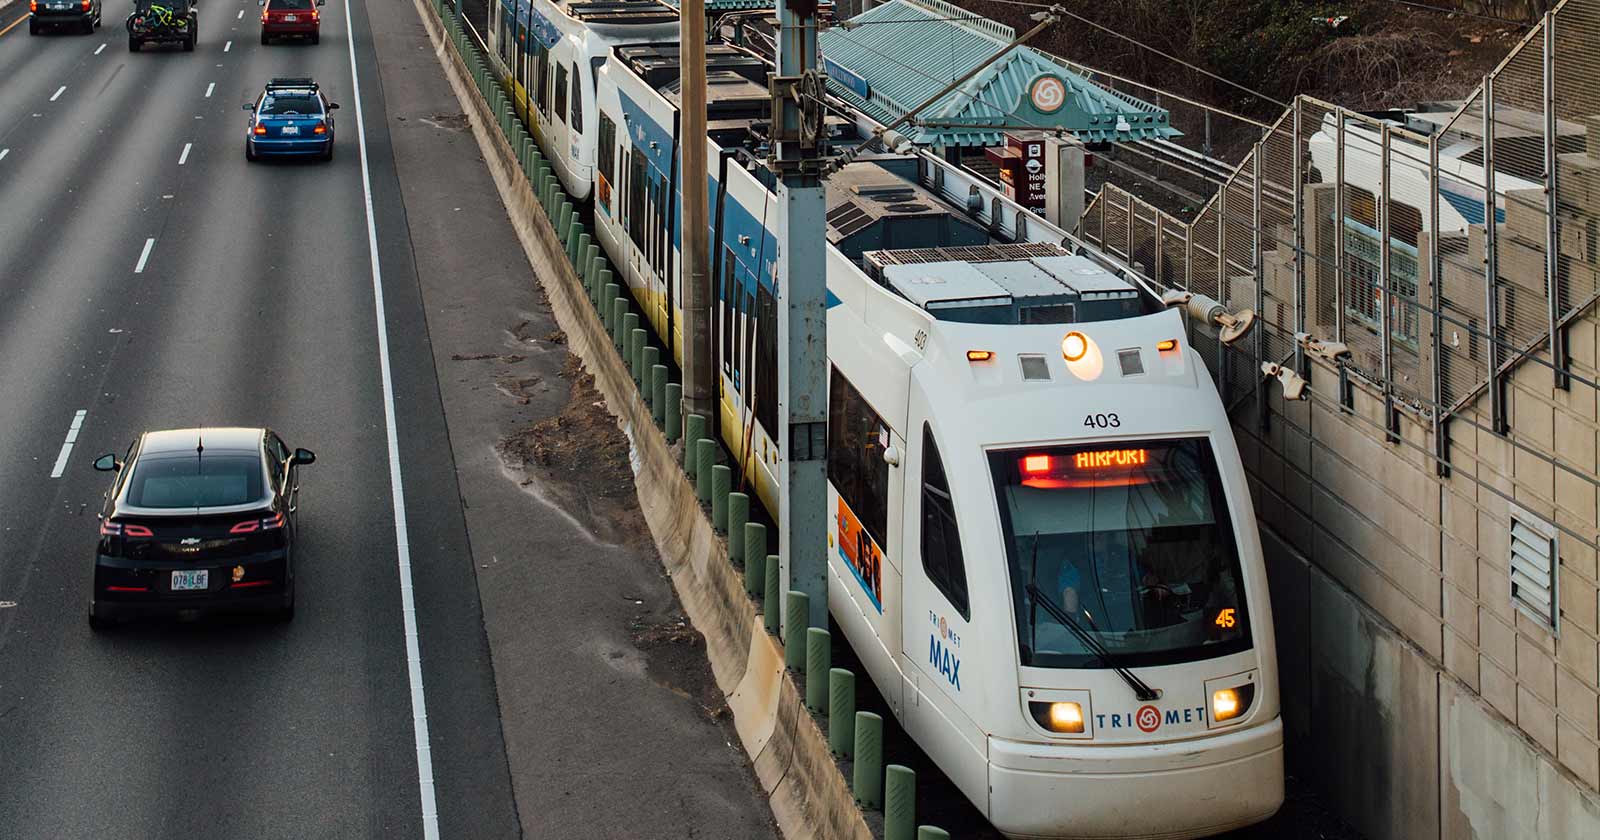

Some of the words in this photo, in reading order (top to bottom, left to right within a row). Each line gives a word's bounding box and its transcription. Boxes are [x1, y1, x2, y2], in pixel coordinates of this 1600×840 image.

[914, 328, 928, 350] 403
[1083, 413, 1121, 429] 403
[1076, 448, 1145, 468] AIRPORT
[1215, 608, 1236, 628] 45
[929, 609, 940, 629] TRI
[948, 627, 961, 649] MET
[929, 633, 961, 692] MAX
[1096, 713, 1132, 728] TRI
[1165, 707, 1205, 725] MET
